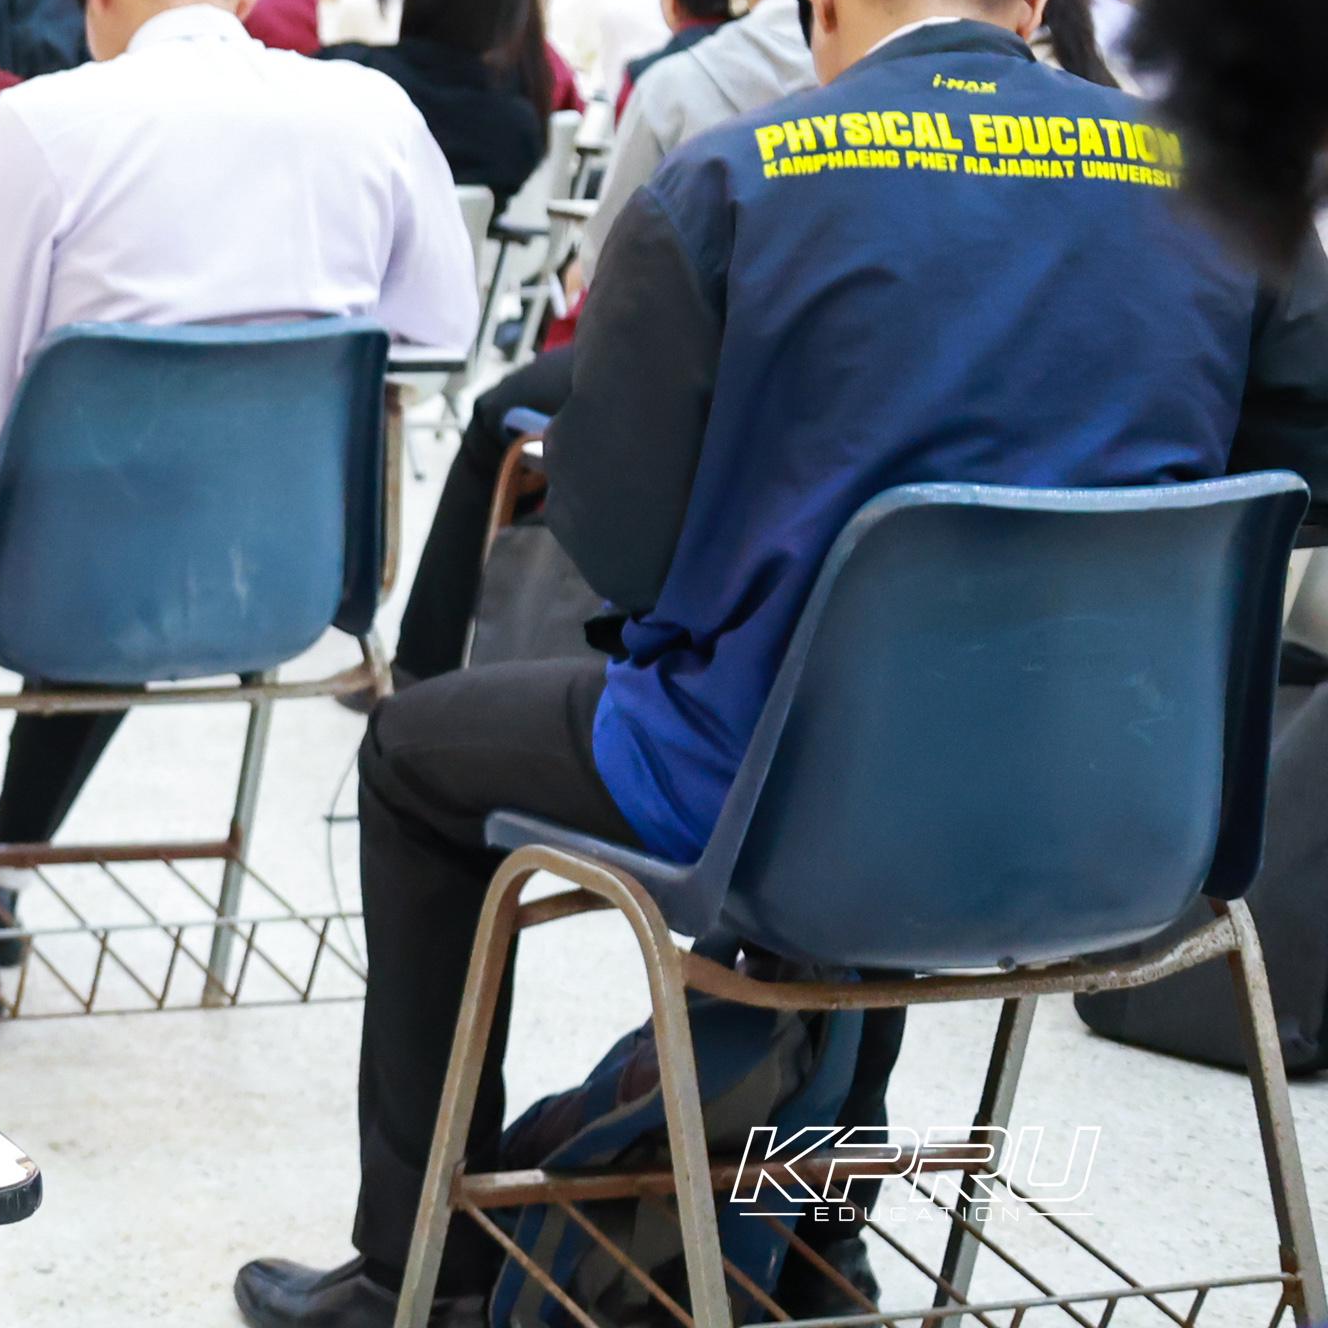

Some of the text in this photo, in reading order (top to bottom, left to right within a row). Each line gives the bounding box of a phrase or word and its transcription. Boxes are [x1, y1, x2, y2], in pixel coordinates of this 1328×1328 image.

[754, 110, 1183, 166] PHYSICAL EDUCATION
[905, 150, 958, 172] PHET
[962, 155, 1075, 179] RAJABHAT
[1081, 160, 1181, 189] UNIVERSIT
